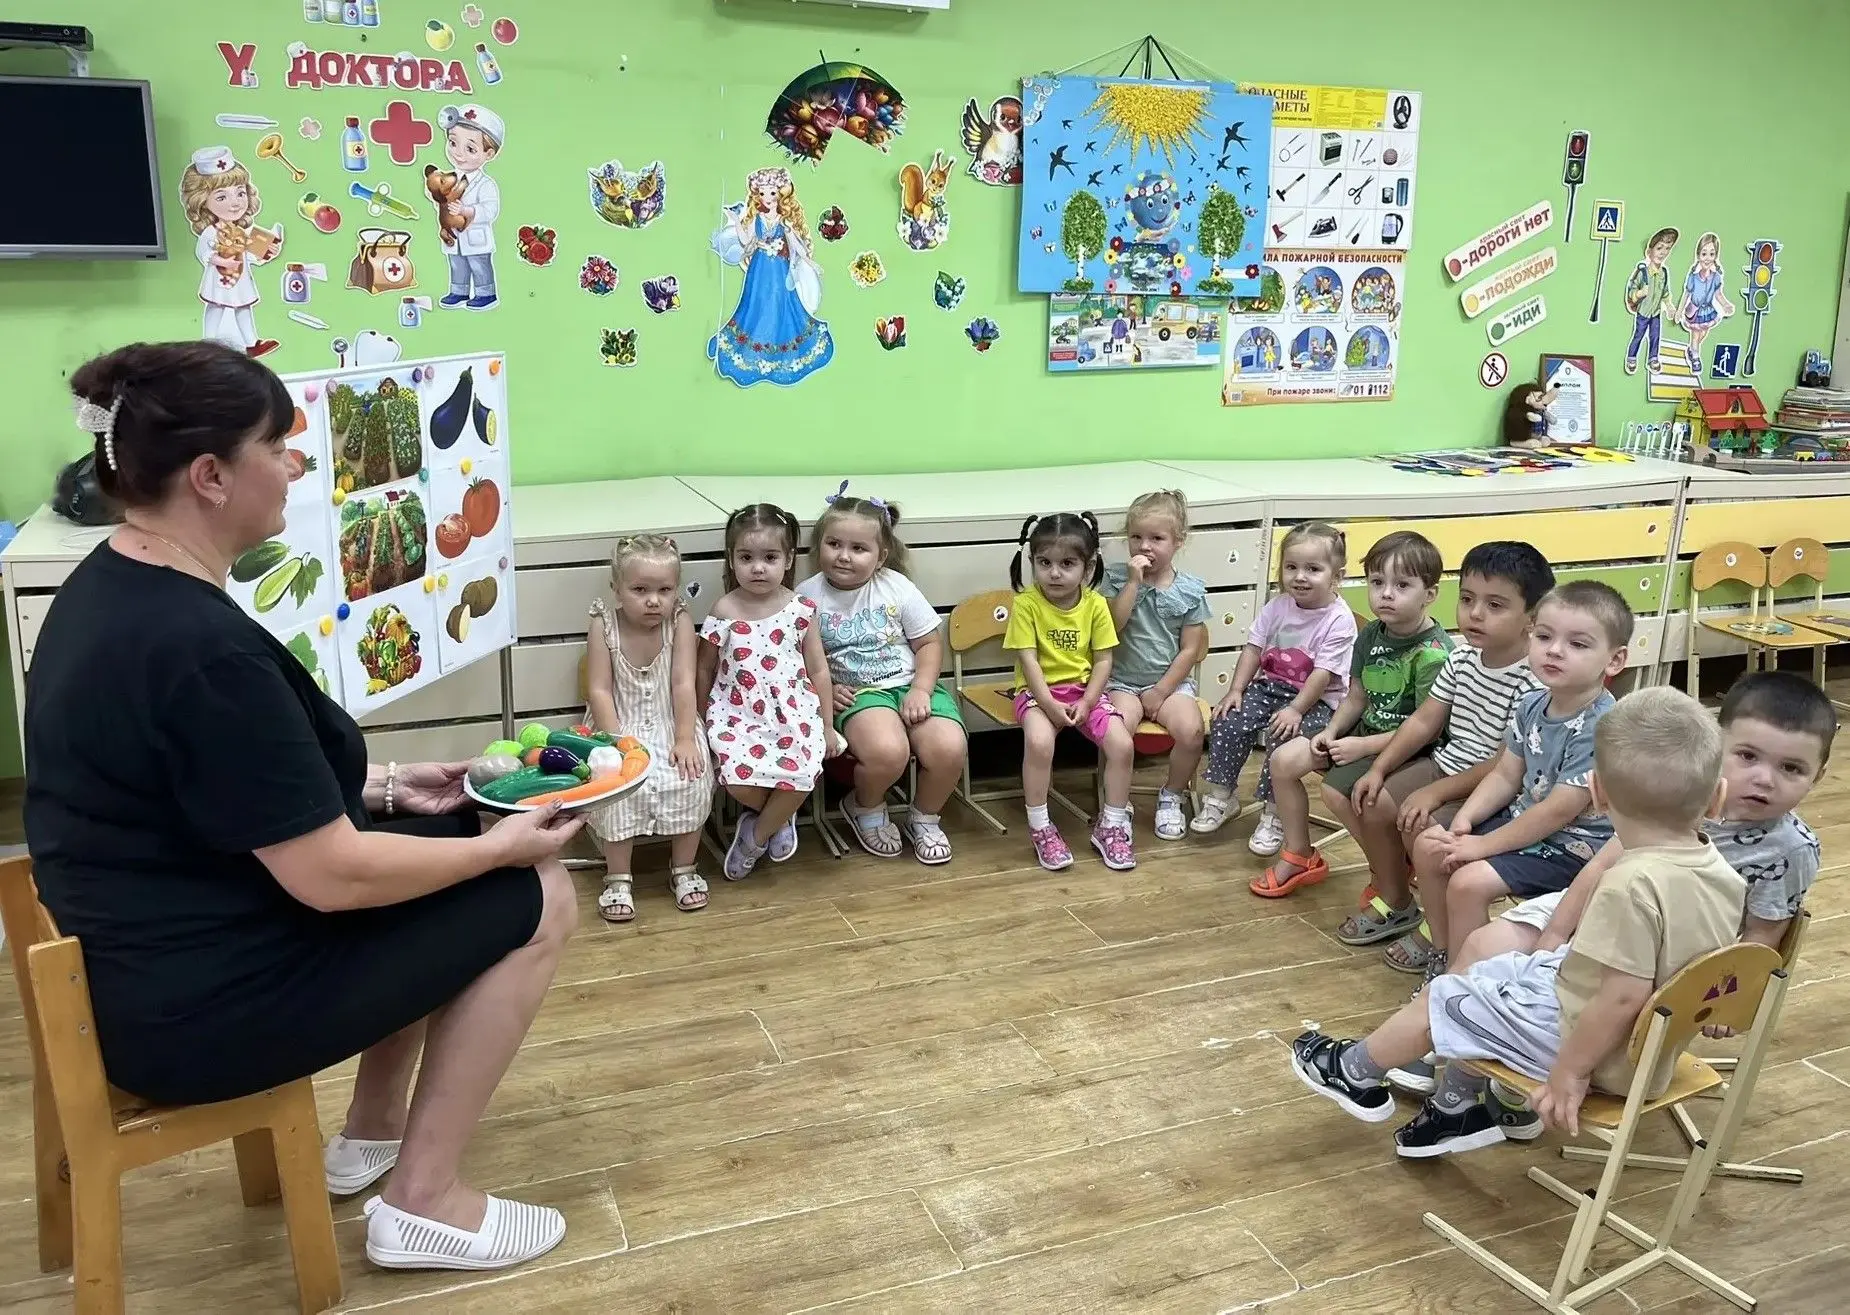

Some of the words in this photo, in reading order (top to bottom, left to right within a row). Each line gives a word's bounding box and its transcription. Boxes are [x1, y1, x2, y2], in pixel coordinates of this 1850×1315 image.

[217, 42, 257, 87] У
[287, 49, 472, 93] ДОКТОРА
[1272, 102, 1310, 112] МЕТЫ
[1480, 223, 1509, 243] красный
[1510, 214, 1526, 227] свет
[1525, 208, 1550, 231] нет
[1282, 252, 1336, 263] ПОЖАРНОЙ
[1338, 254, 1403, 263] БЕЗОПАСНОСТИ
[1267, 387, 1285, 396] При
[1286, 388, 1311, 396] пожаре
[1312, 387, 1336, 395] звони:
[1353, 386, 1364, 395] 01
[1373, 384, 1388, 394] 112
[820, 606, 888, 640] Let's
